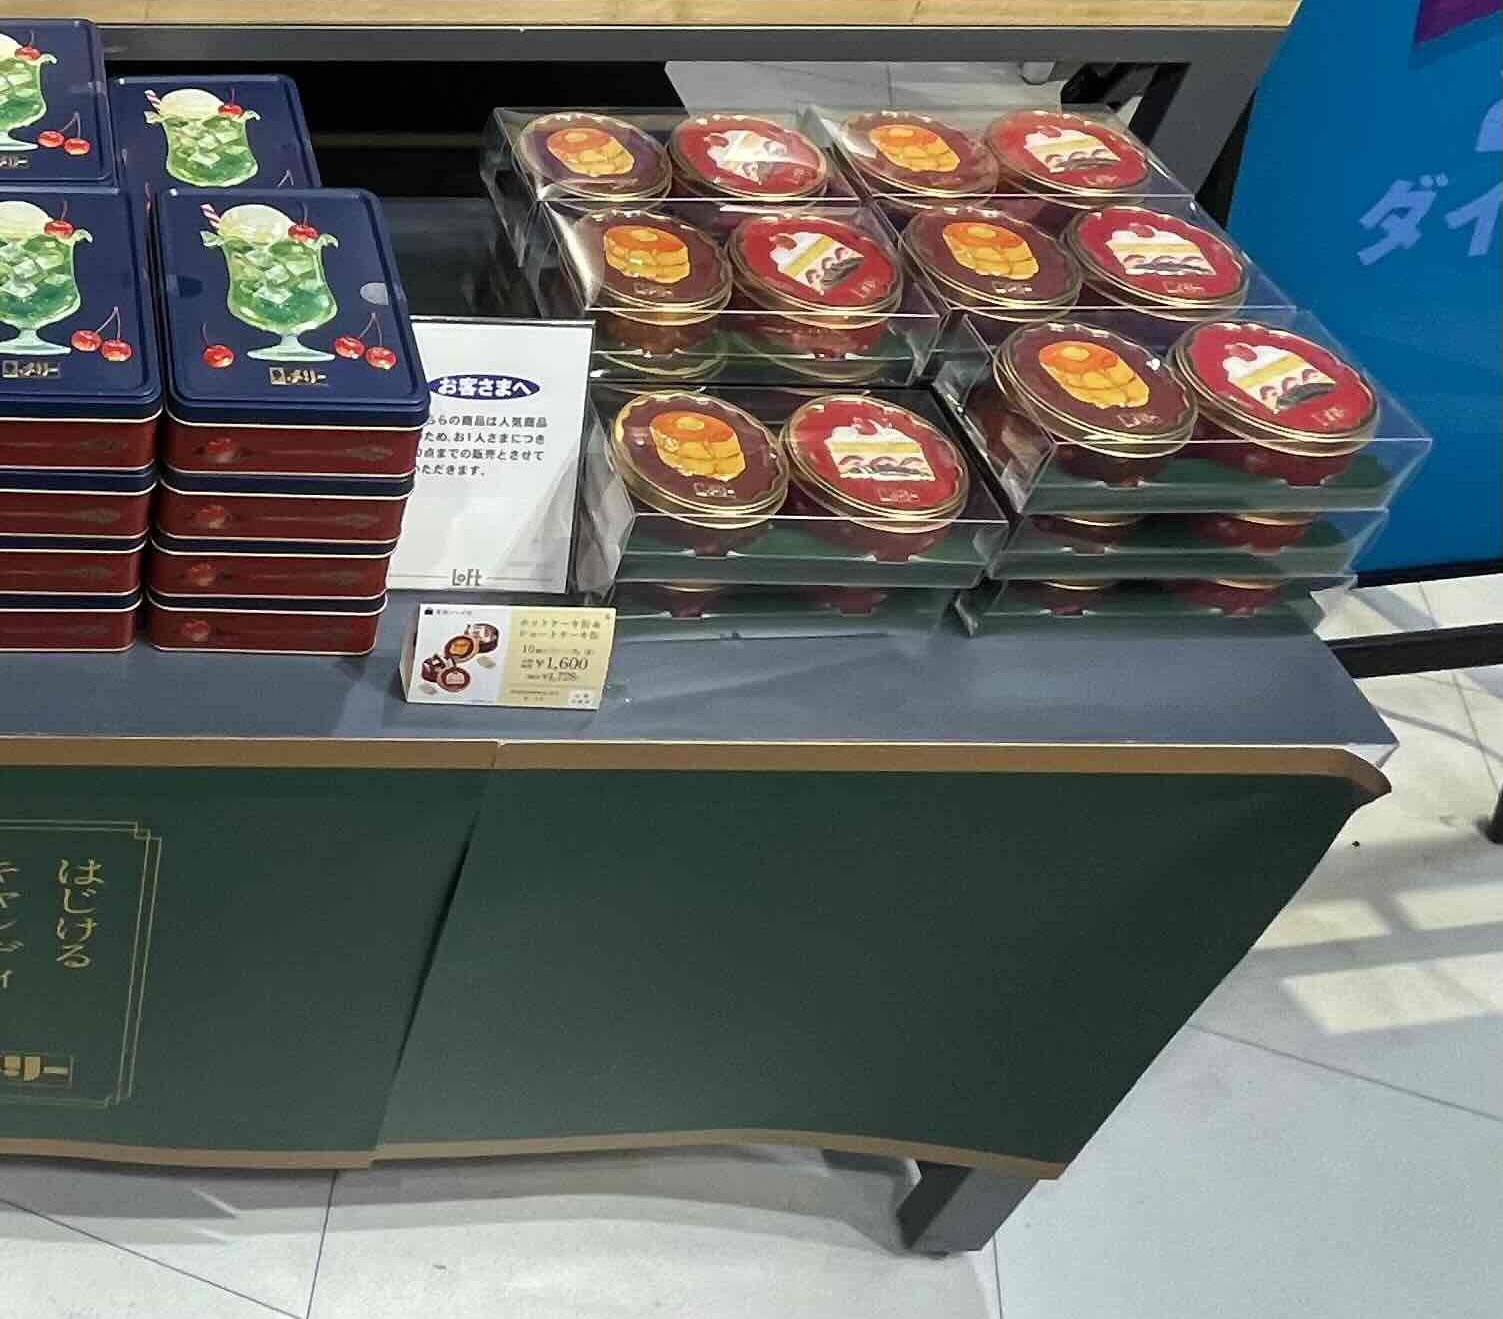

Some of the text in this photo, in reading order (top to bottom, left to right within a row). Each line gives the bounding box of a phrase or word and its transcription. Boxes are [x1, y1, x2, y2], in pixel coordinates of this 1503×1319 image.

[1358, 171, 1503, 266] ダイ
[437, 377, 532, 397] お客さまへ
[534, 656, 589, 671] ¥1,600
[55, 858, 105, 969] はじける
